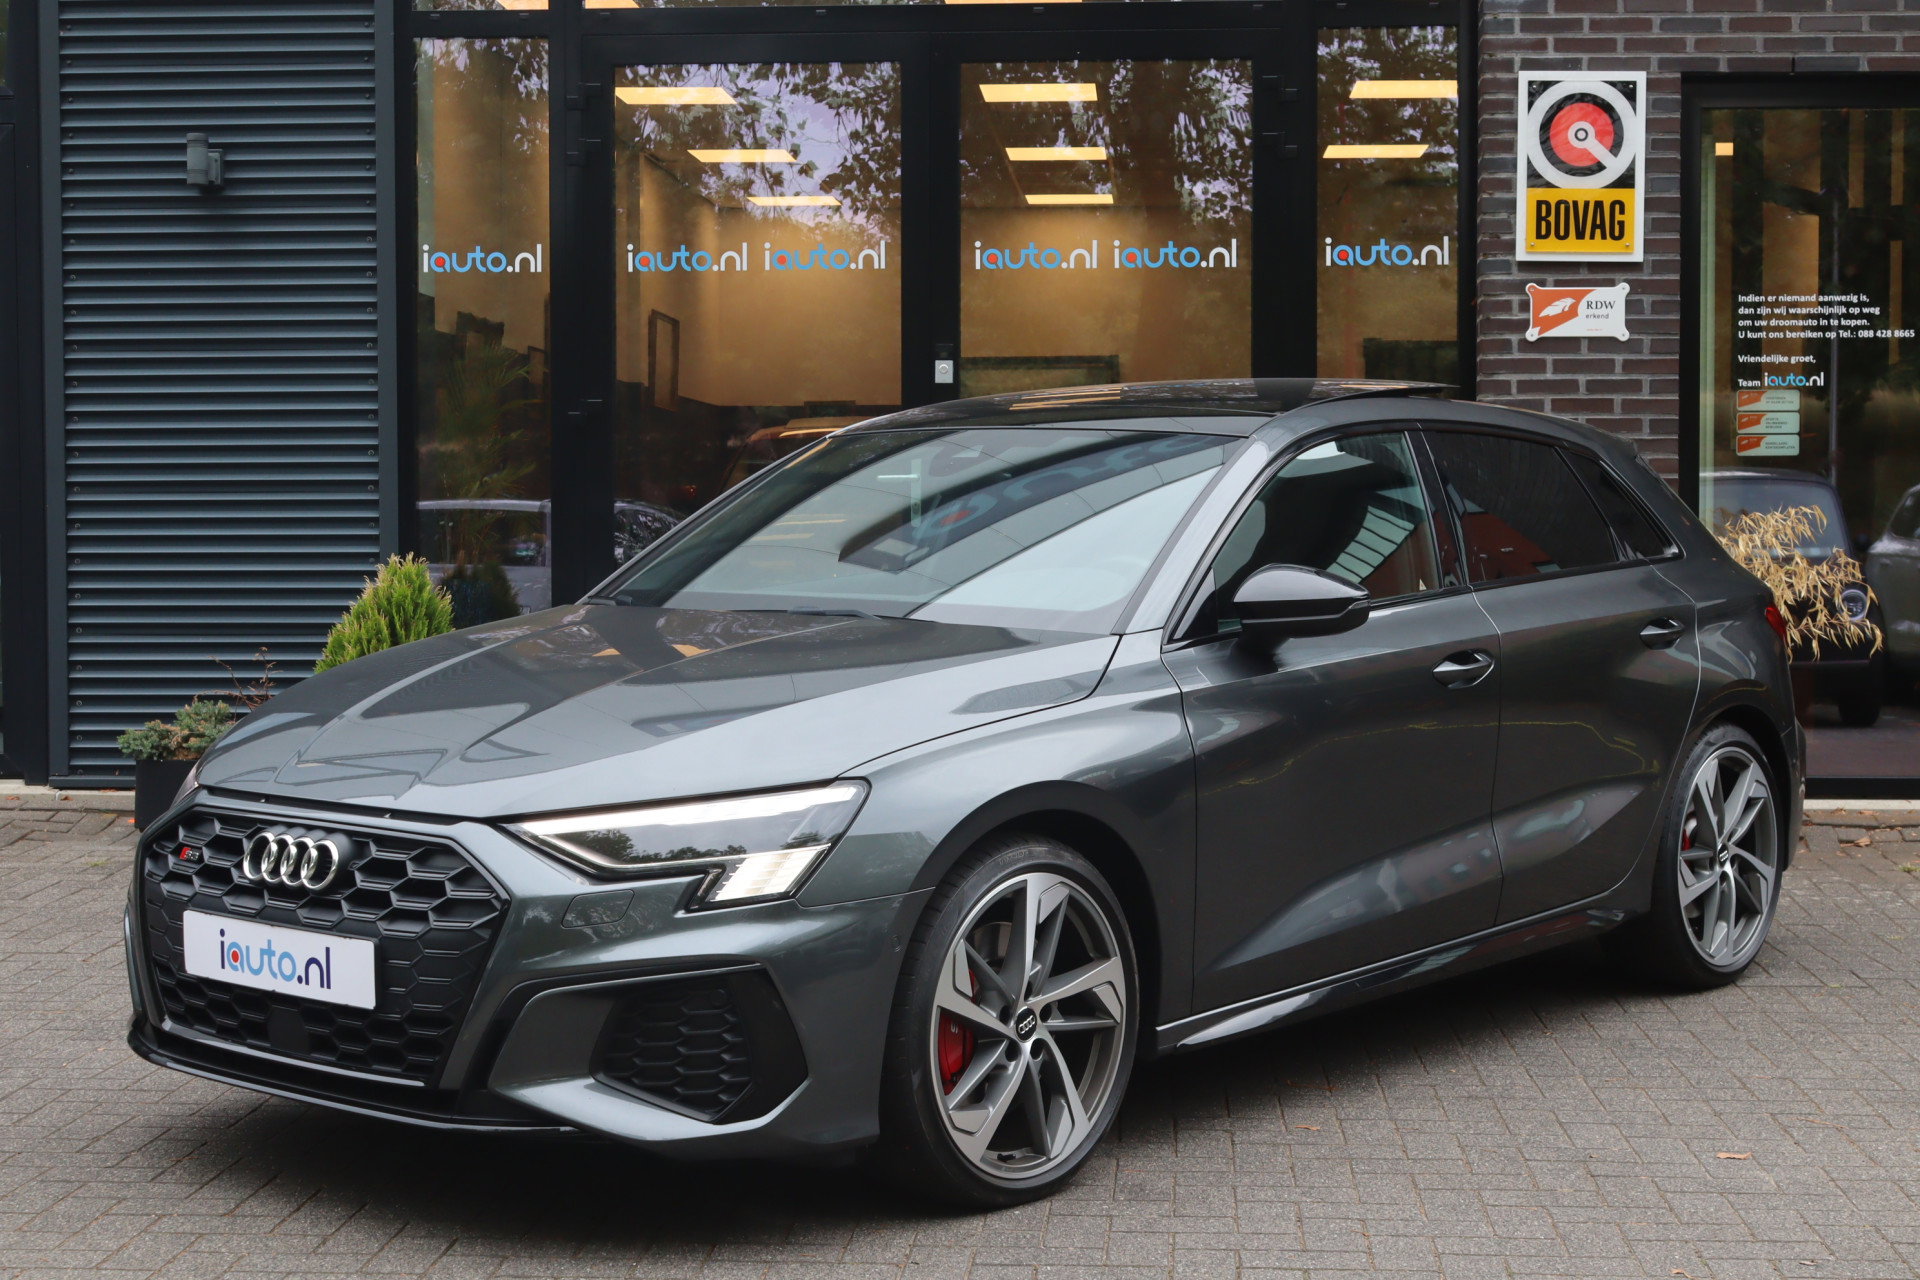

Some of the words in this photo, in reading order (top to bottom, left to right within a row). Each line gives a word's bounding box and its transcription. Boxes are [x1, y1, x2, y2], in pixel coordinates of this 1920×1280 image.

[1535, 199, 1626, 241] BOVAG
[626, 241, 748, 273] iauto.nl
[763, 240, 886, 271] iauto.nl
[974, 239, 1098, 270] iauto.nl
[1113, 238, 1238, 269] iauto.nl
[1324, 236, 1450, 267] iauto.nl
[421, 243, 543, 273] iauto.nl
[1738, 294, 1765, 302] Indien
[1778, 294, 1816, 302] niemand
[1818, 294, 1858, 303] aanwezig
[1860, 294, 1870, 302] is,
[1585, 300, 1616, 310] RDW
[1738, 306, 1754, 314] dan
[1756, 306, 1771, 315] zijn
[1773, 306, 1787, 315] wij
[1788, 306, 1847, 315] waarschijnlijk
[1849, 307, 1860, 315] op
[1862, 307, 1880, 315] weg
[1585, 312, 1609, 320] erkend
[1769, 318, 1818, 326] droomauto
[1819, 318, 1828, 326] in
[1841, 318, 1870, 328] kopen.
[1786, 330, 1823, 338] bereiken
[1825, 331, 1837, 340] op
[1839, 330, 1856, 338] Tel.:
[1858, 330, 1874, 338] 088
[1876, 330, 1892, 338] 428
[1894, 330, 1915, 338] 8665
[1738, 355, 1789, 364] Vriendelijke
[1791, 355, 1816, 364] groet,
[1764, 372, 1824, 386] iauto.nl
[220, 928, 331, 990] iauto.nl
